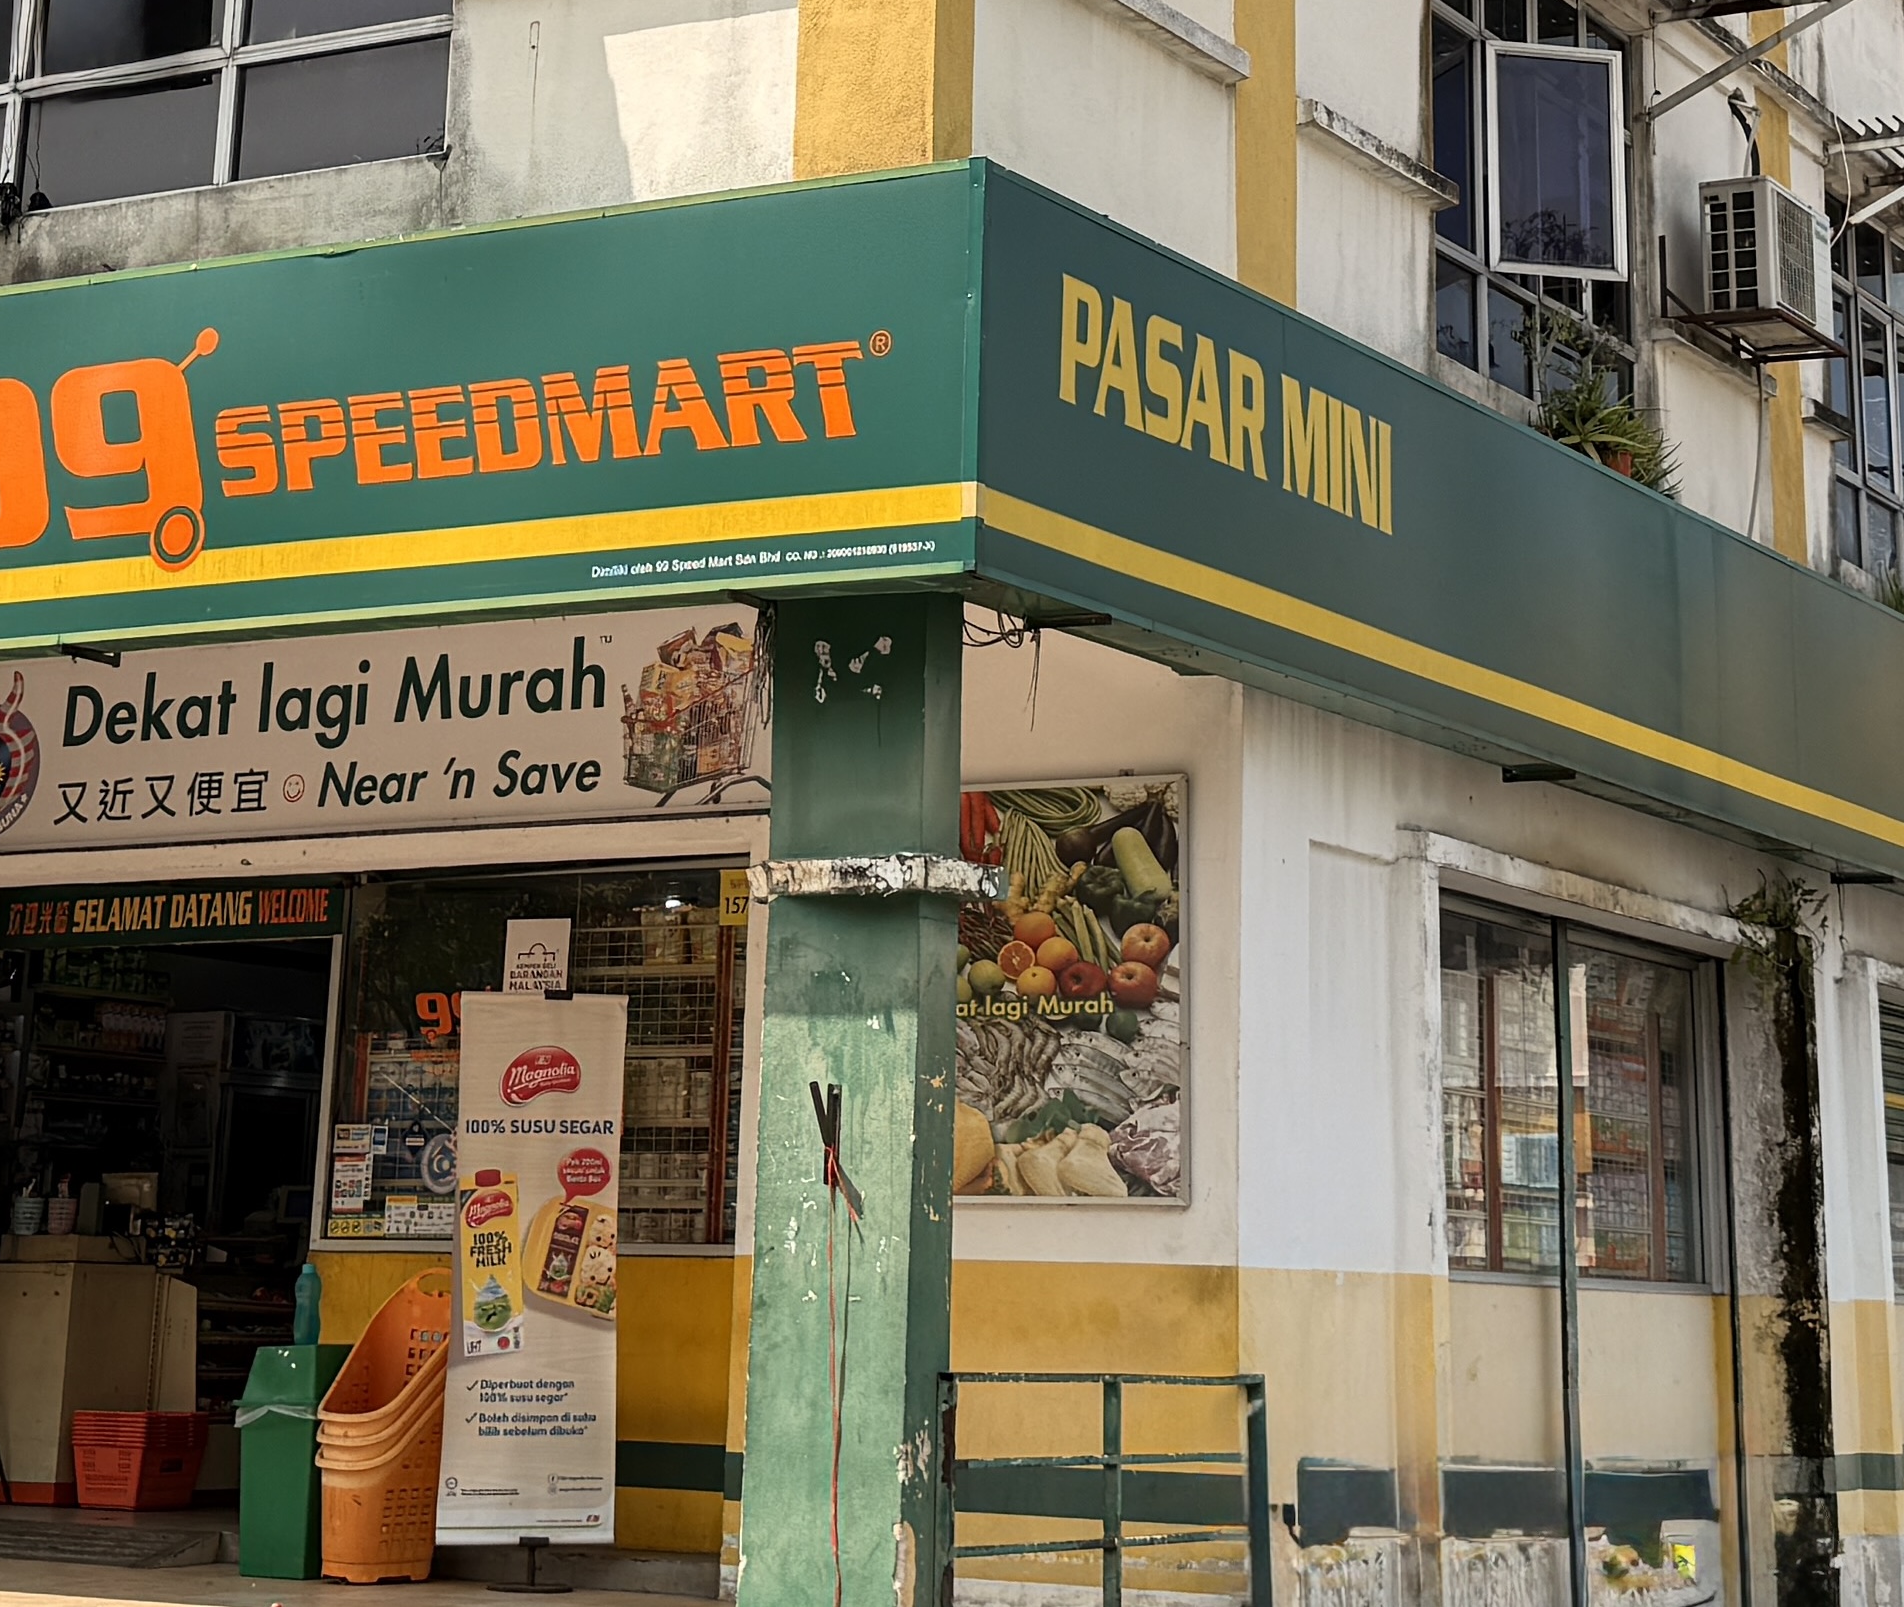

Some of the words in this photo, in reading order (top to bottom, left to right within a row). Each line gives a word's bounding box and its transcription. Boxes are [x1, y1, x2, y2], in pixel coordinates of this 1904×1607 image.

[1059, 272, 1268, 482] PASAR
[1281, 373, 1392, 535] MINI
[215, 340, 864, 497] SPEEDMART
[708, 555, 733, 569] Mart
[759, 550, 781, 564] Bhd
[62, 672, 237, 748] Dekat
[258, 659, 371, 750] lagi
[394, 636, 607, 723] Murah
[317, 761, 428, 808] Near
[492, 750, 601, 797] Save
[53, 768, 270, 826] 又近又便宜
[71, 895, 167, 933] SELAMAT
[169, 890, 253, 929] DATANG
[258, 888, 330, 925] WELCOME
[724, 896, 749, 915] 157
[415, 991, 461, 1043] 9
[985, 995, 1029, 1022] lagi
[1037, 991, 1115, 1016] Murah
[508, 1062, 577, 1088] Magnolia
[466, 1119, 506, 1134] 100%
[510, 1119, 556, 1135] SUSU
[559, 1120, 615, 1135] SEGAR
[473, 1230, 508, 1245] 100%
[470, 1242, 512, 1257] FRESH
[476, 1254, 507, 1268] MILK
[480, 1379, 533, 1393] Diperbuat
[536, 1378, 575, 1392] dengan
[510, 1394, 533, 1403] susu
[479, 1413, 509, 1423] Boleh
[511, 1412, 559, 1425] disimpan
[561, 1412, 571, 1422] di
